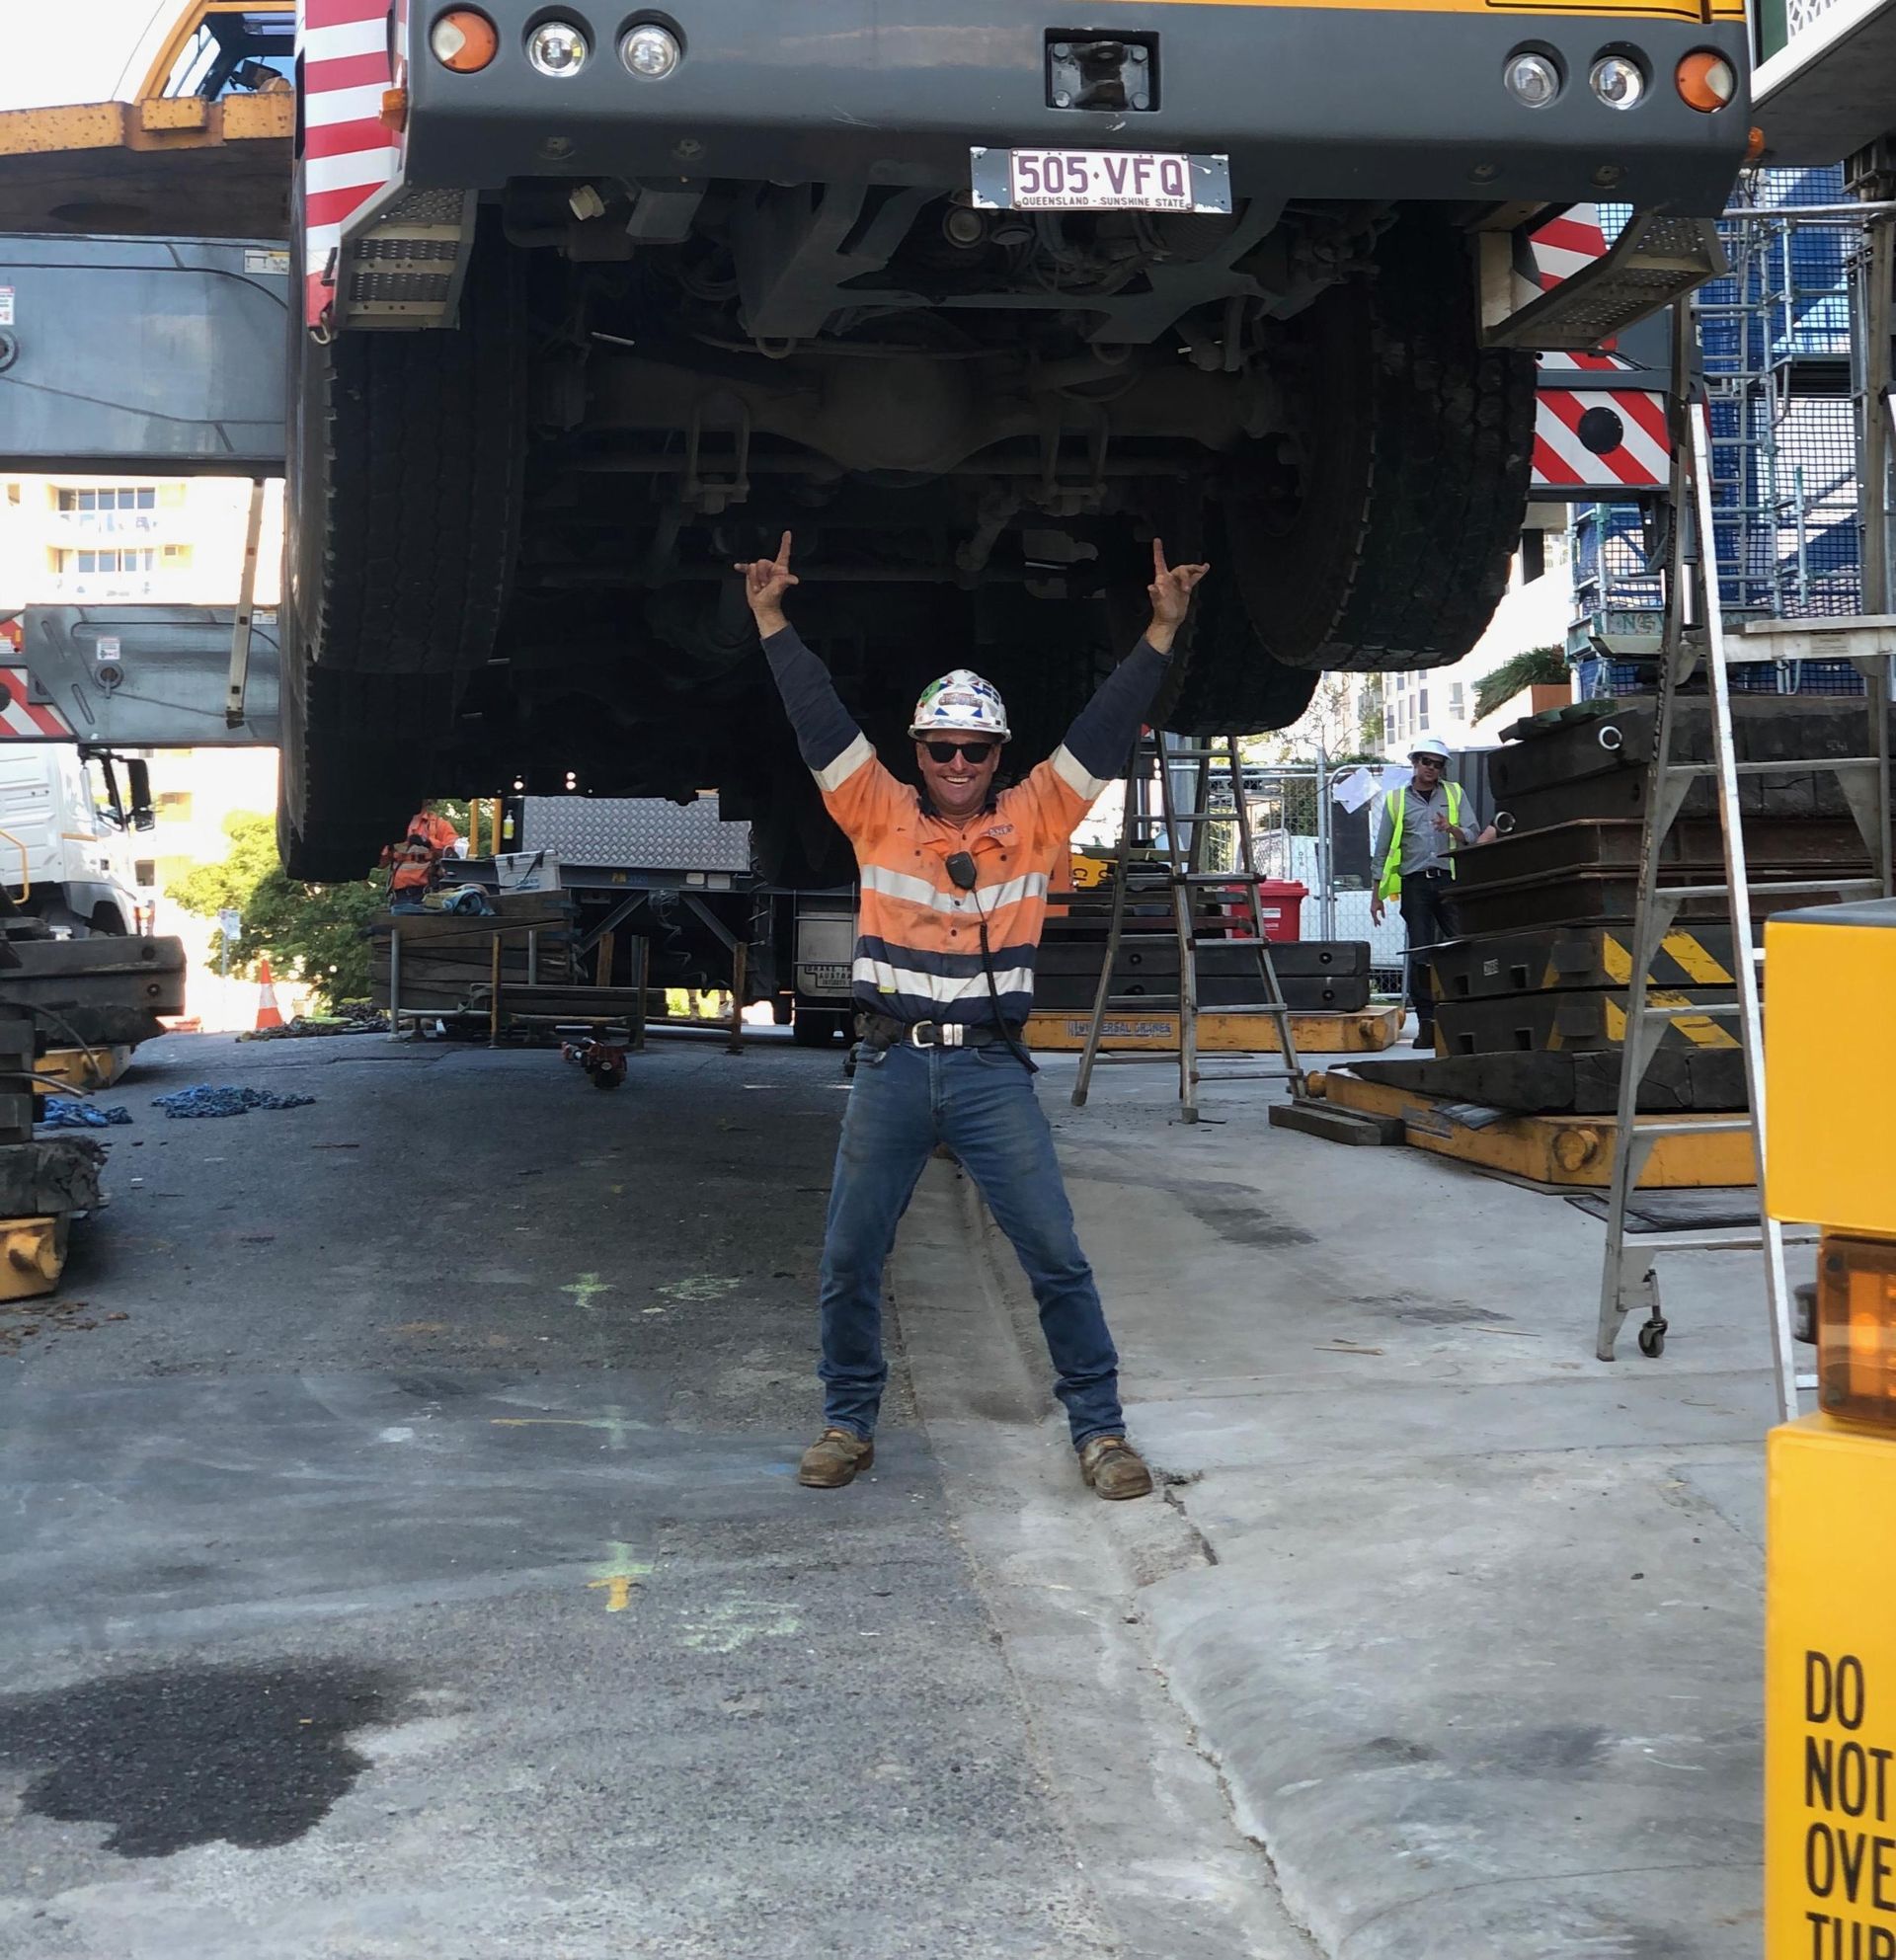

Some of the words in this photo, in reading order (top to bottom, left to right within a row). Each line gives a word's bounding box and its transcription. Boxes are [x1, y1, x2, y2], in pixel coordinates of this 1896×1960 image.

[1022, 196, 1089, 205] QUEENSLAND
[1100, 196, 1150, 206] SUNSHINE
[1155, 197, 1185, 206] STATE
[1805, 1650, 1865, 1730] DO
[1805, 1735, 1894, 1822] NOT
